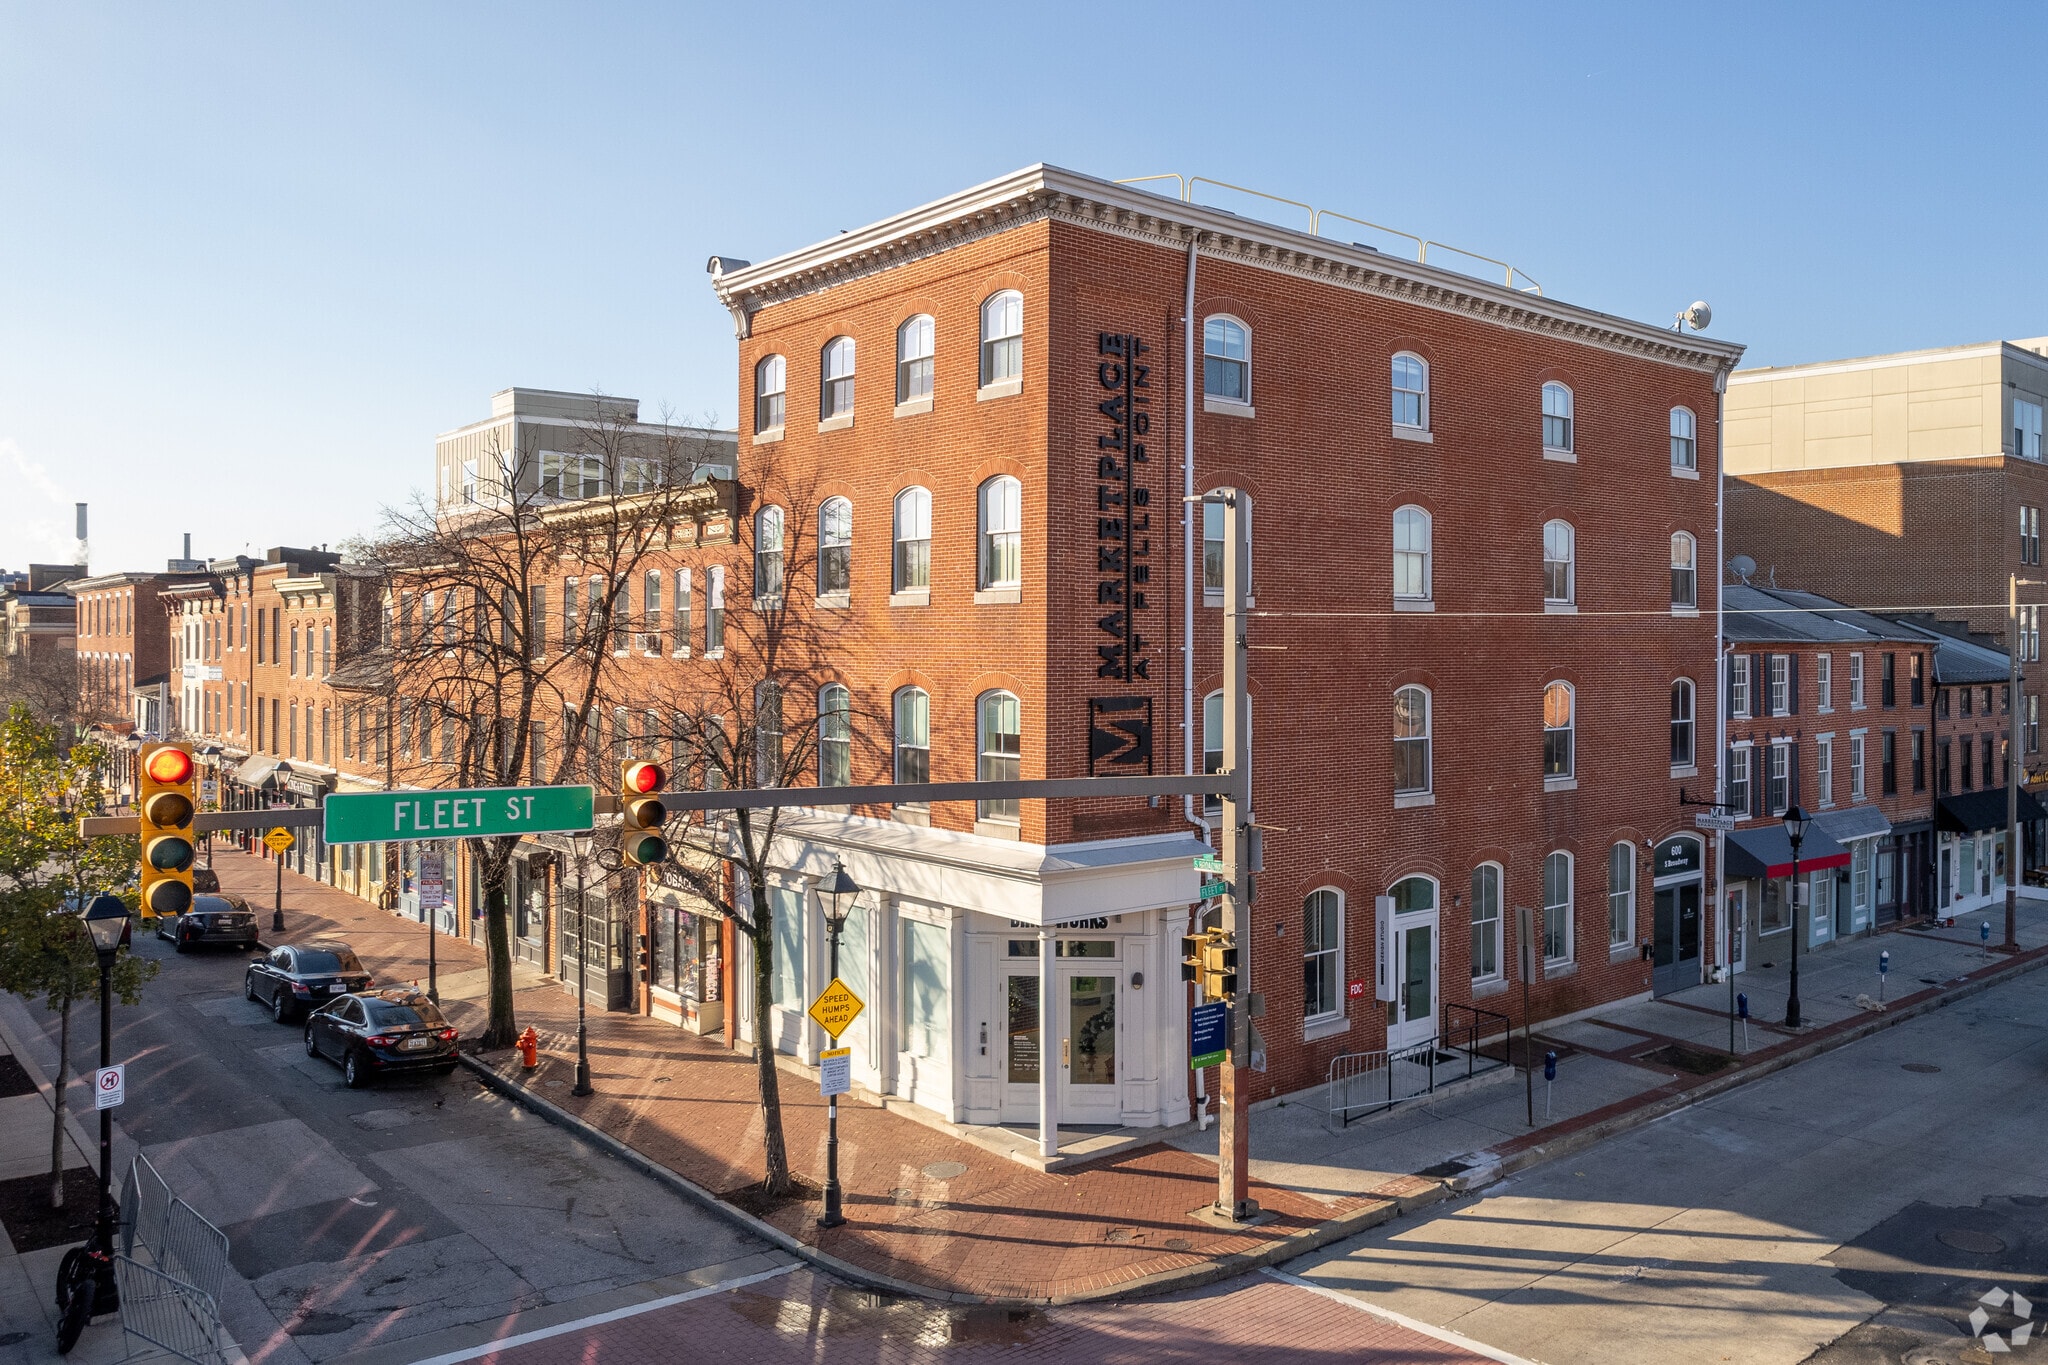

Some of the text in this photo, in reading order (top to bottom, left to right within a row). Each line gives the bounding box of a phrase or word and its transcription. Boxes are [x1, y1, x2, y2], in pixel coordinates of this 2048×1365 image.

[1098, 332, 1124, 679] MARKETPLACE
[1134, 337, 1150, 680] AT FELLS POINT
[394, 796, 535, 831] FLEET ST
[1710, 807, 1719, 818] M
[1671, 845, 1682, 856] 600
[1667, 858, 1689, 867] Broadway
[1201, 886, 1218, 898] FLEET
[1350, 983, 1363, 995] FDC
[823, 993, 849, 1004] SPEED
[822, 1003, 850, 1014] HUMPS
[824, 1014, 849, 1024] AHEAD
